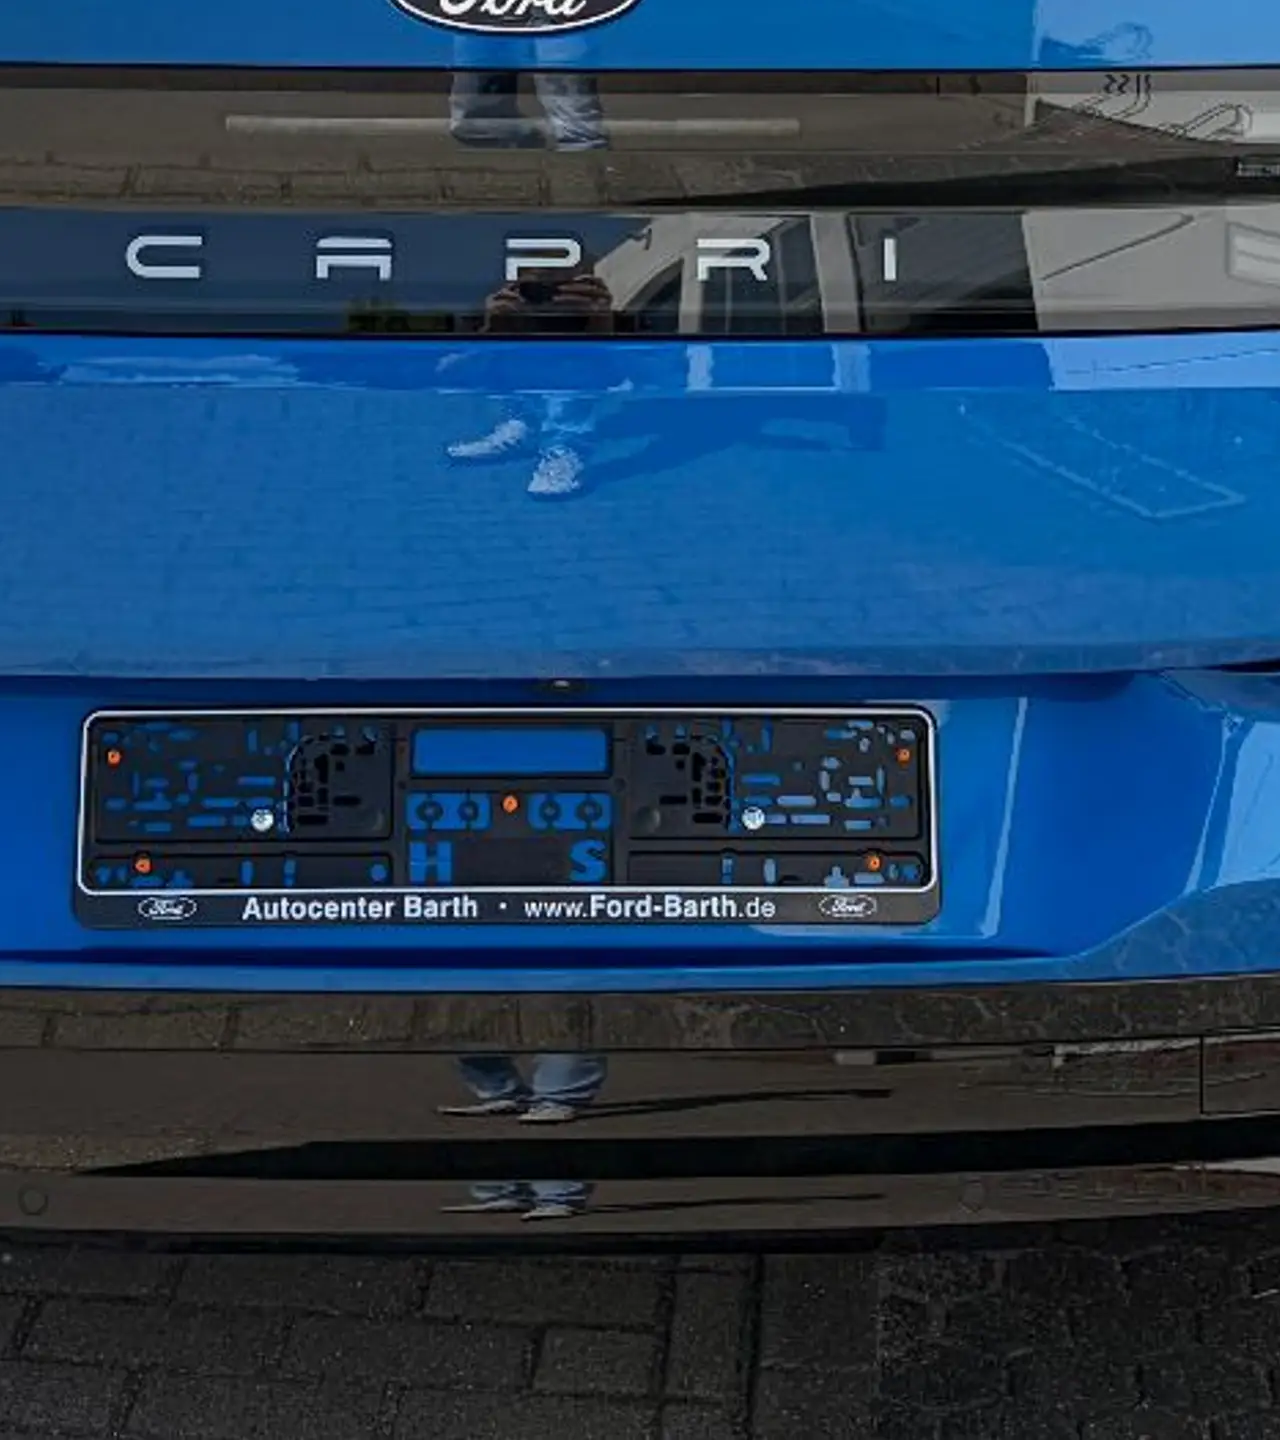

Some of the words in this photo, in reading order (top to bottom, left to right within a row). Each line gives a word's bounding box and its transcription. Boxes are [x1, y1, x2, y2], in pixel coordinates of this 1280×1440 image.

[124, 235, 897, 282] CAPRI
[241, 896, 395, 921] Autocenter
[403, 895, 478, 919] Barth
[523, 894, 776, 919] www.Ford-Barth.de
